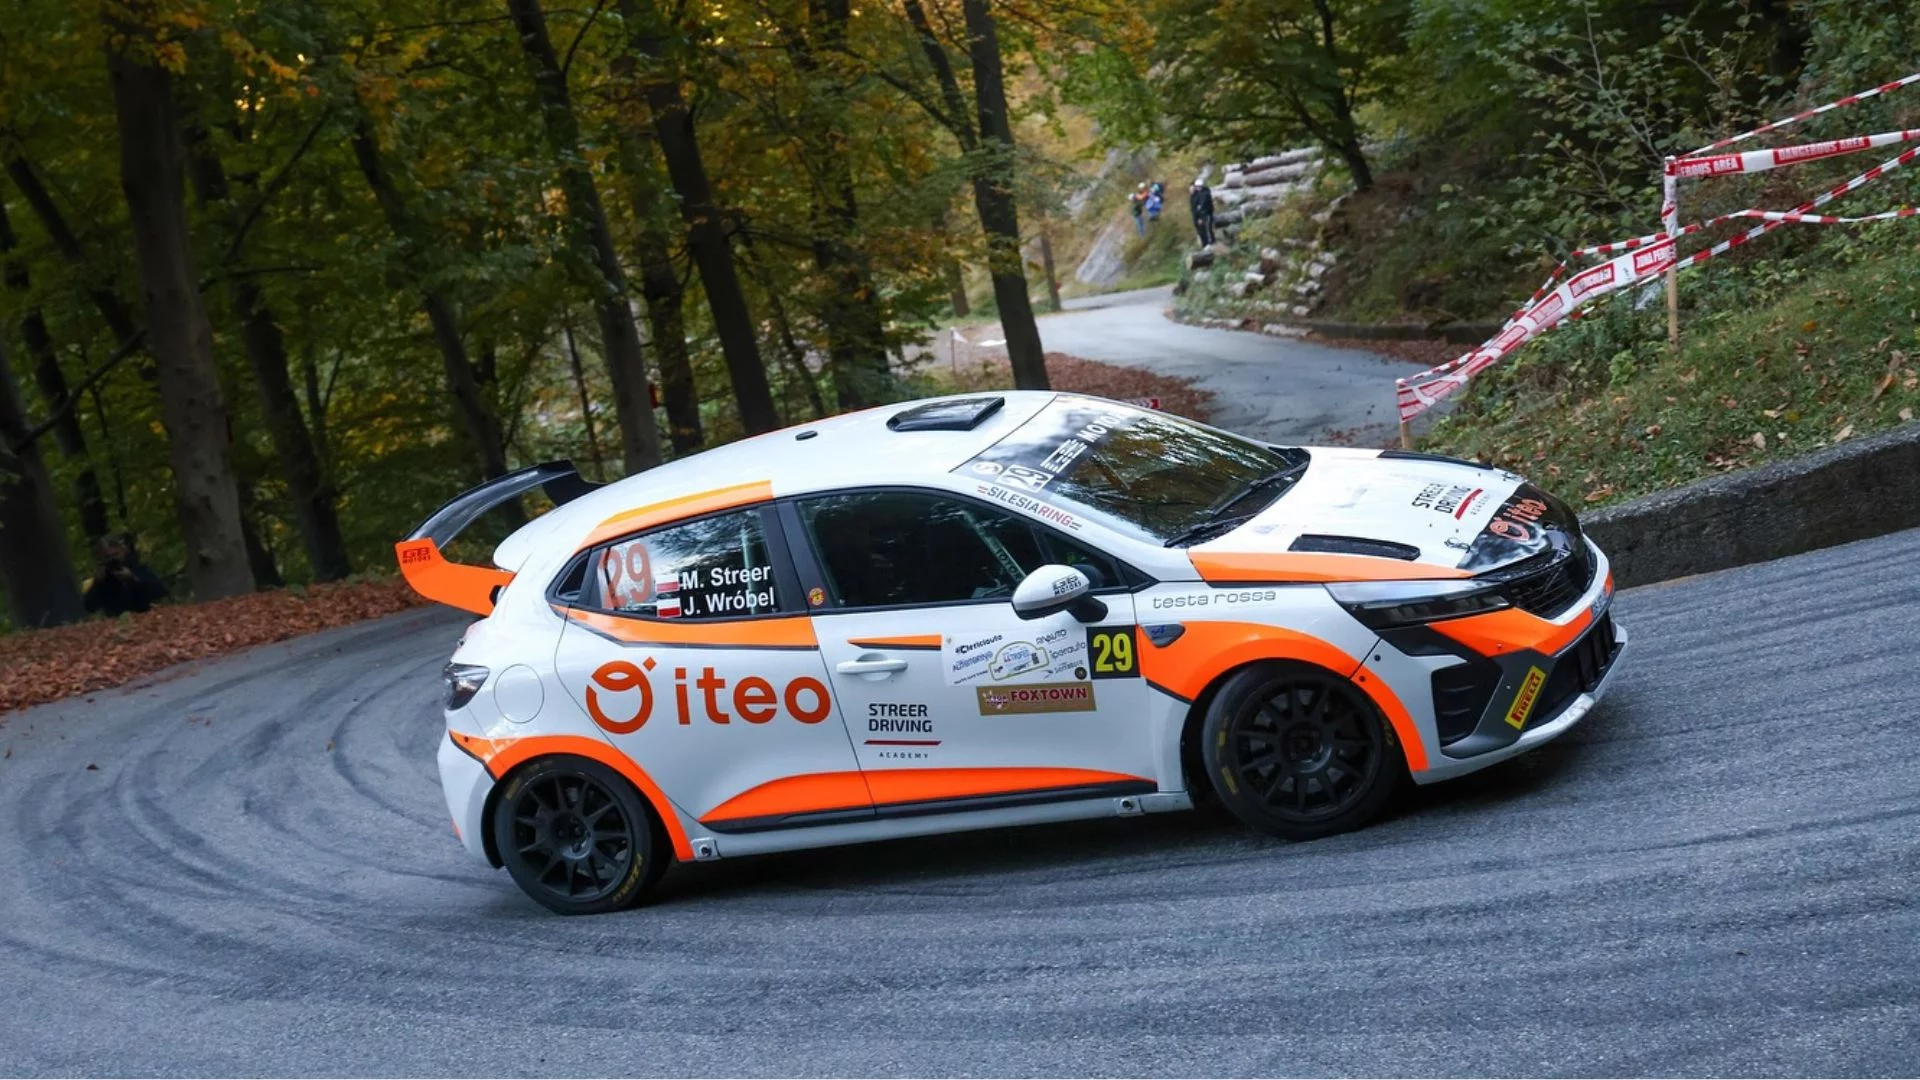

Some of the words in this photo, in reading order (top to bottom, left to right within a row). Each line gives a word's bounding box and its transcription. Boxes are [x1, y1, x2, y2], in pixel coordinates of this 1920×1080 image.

[1839, 137, 1865, 151] AREA
[1713, 158, 1739, 173] AREA
[987, 486, 1074, 526] SILESIARING
[598, 543, 651, 609] 29
[682, 571, 704, 590] M.
[710, 565, 771, 587] Streer
[683, 597, 701, 616] J.
[705, 588, 775, 613] Wróbel
[1153, 594, 1209, 609] testa
[1214, 590, 1276, 604] rossa
[1092, 633, 1133, 673] 29
[674, 667, 832, 725] iteo
[1010, 688, 1088, 701] FOXTOWN
[868, 703, 928, 717] STREER
[868, 718, 933, 733] DRIVING
